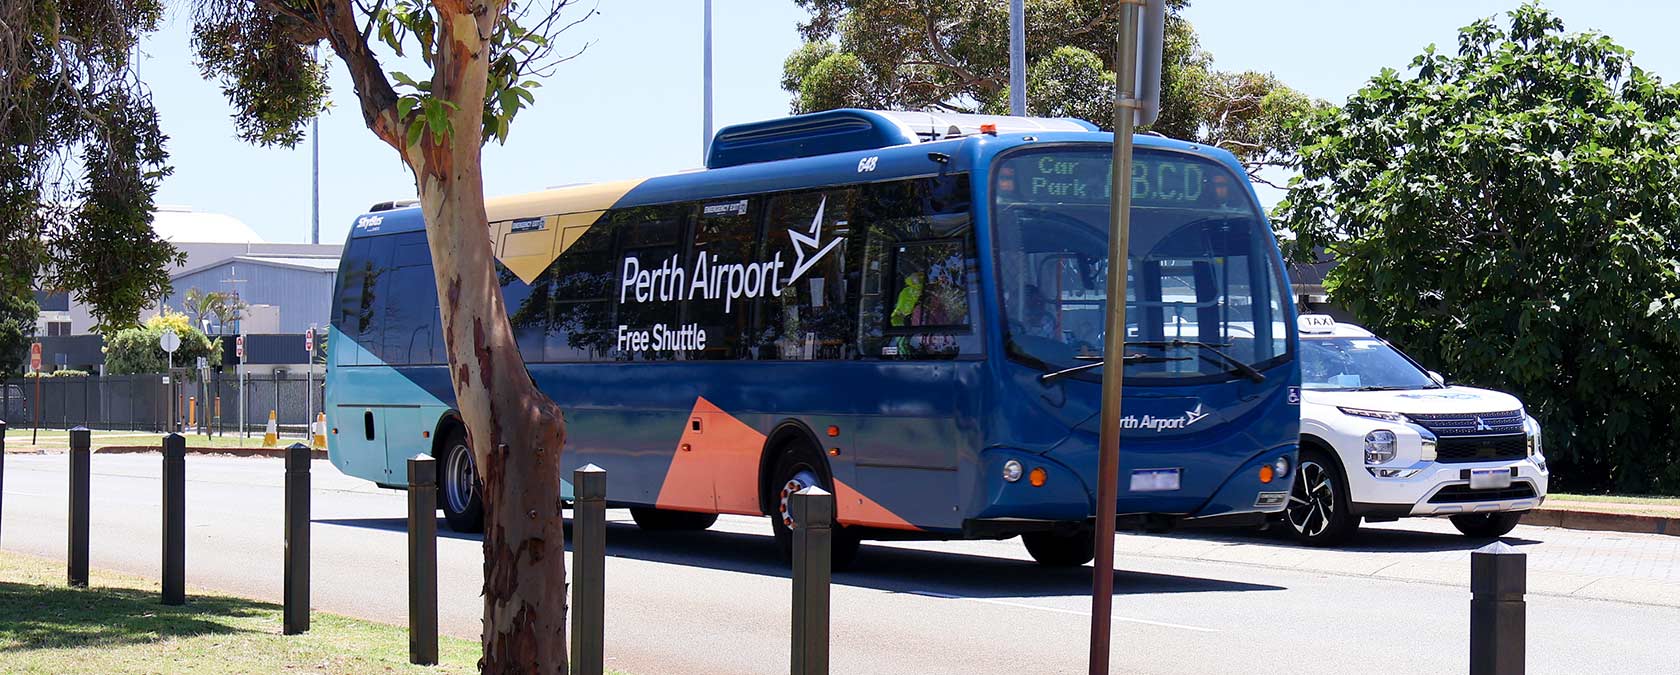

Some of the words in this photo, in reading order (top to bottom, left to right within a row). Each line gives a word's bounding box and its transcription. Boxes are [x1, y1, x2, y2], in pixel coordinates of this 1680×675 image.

[857, 156, 878, 172] 648
[1038, 156, 1079, 174] Car
[1032, 177, 1087, 196] Park
[620, 253, 685, 304] Perth
[688, 250, 784, 314] Airport
[1304, 317, 1334, 326] TAXI
[617, 325, 649, 351] Free
[652, 322, 706, 351] Shuttle
[1120, 415, 1138, 428] rth
[1139, 414, 1186, 432] Airport
